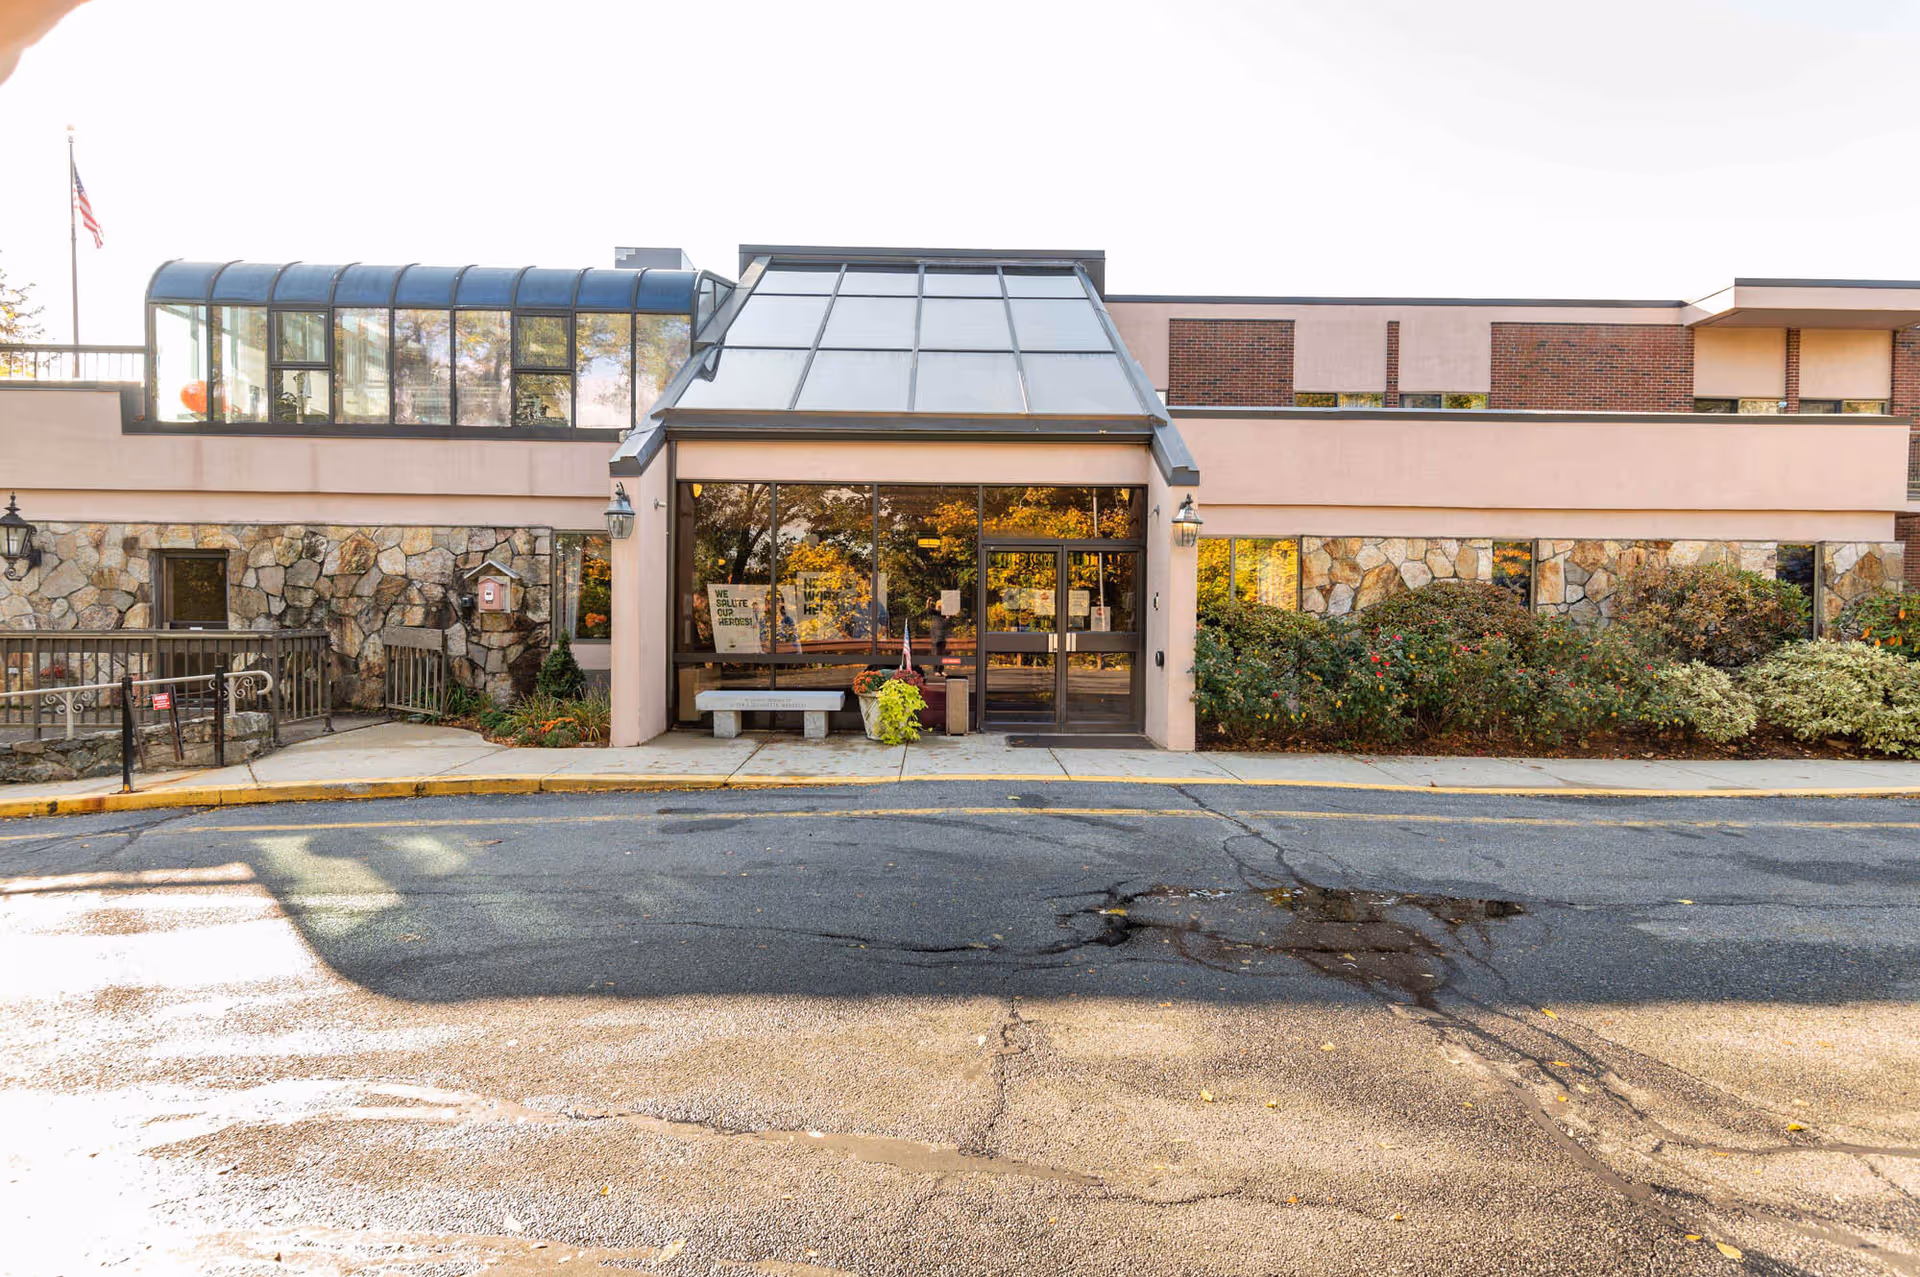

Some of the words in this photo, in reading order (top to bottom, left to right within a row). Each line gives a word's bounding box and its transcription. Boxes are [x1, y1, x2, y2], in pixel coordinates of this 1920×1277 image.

[714, 589, 729, 599] WE
[715, 599, 749, 608] SALUTE
[717, 608, 734, 617] OUR
[718, 617, 753, 627] HEROES!
